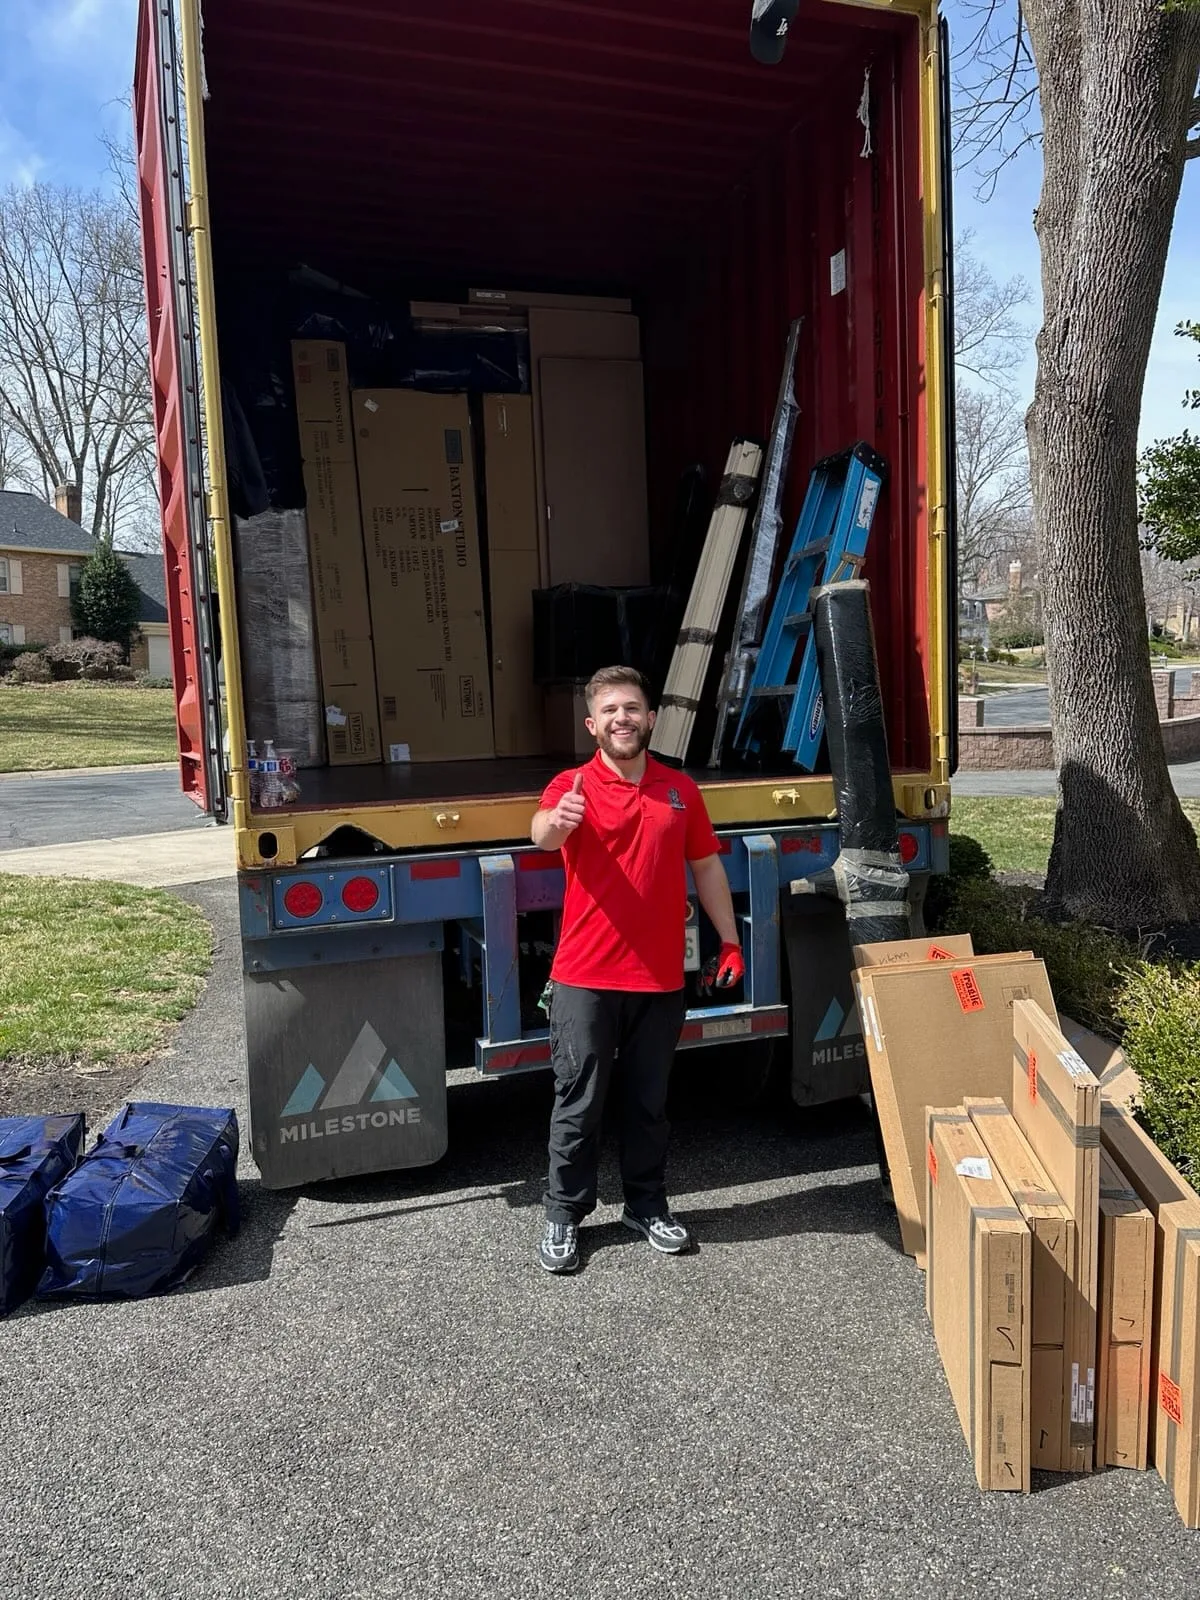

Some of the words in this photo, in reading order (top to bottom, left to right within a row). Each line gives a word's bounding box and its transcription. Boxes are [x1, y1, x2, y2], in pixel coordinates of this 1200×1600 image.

[449, 466, 464, 518] BAXTON
[408, 507, 418, 539] CARTON
[417, 507, 427, 540] COLOUR
[812, 696, 823, 730] WERNER
[962, 972, 980, 1007] fragile
[811, 1042, 865, 1067] MILES
[280, 1107, 421, 1145] MILESTONE
